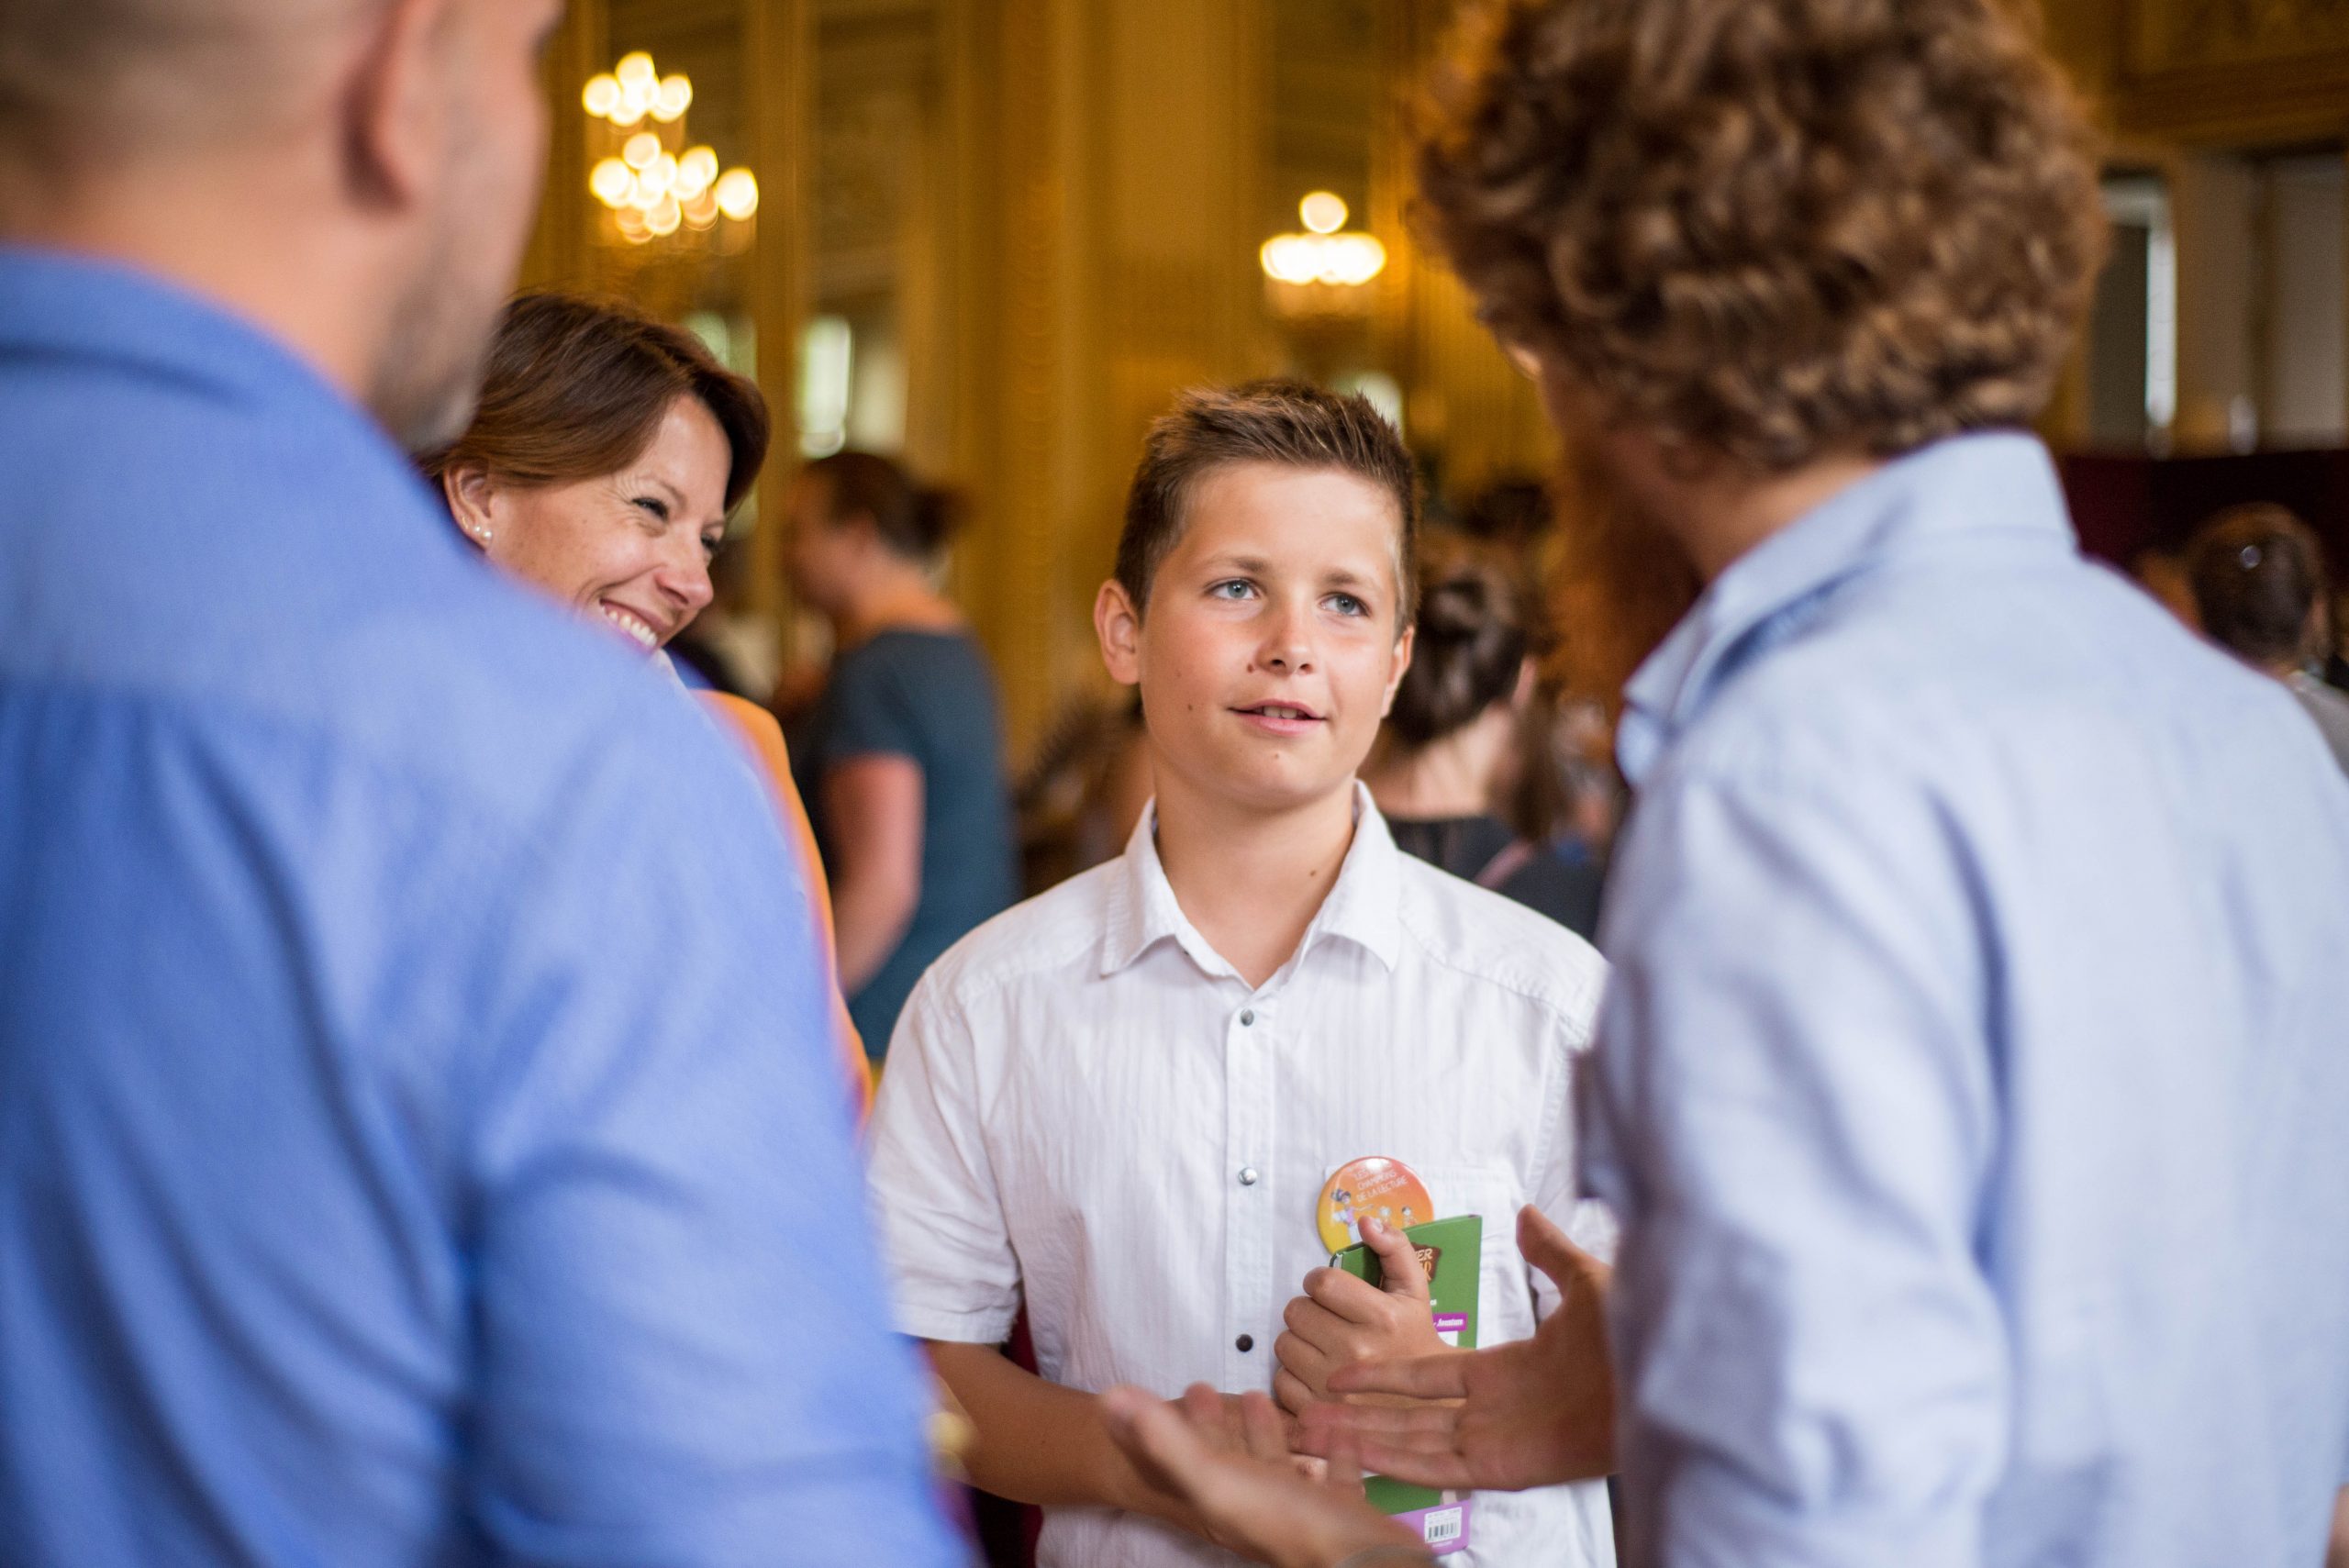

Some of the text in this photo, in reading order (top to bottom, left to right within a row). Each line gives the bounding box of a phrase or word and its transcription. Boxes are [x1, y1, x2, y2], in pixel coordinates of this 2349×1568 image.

[1356, 1176, 1408, 1202] DE LA LECTURE
